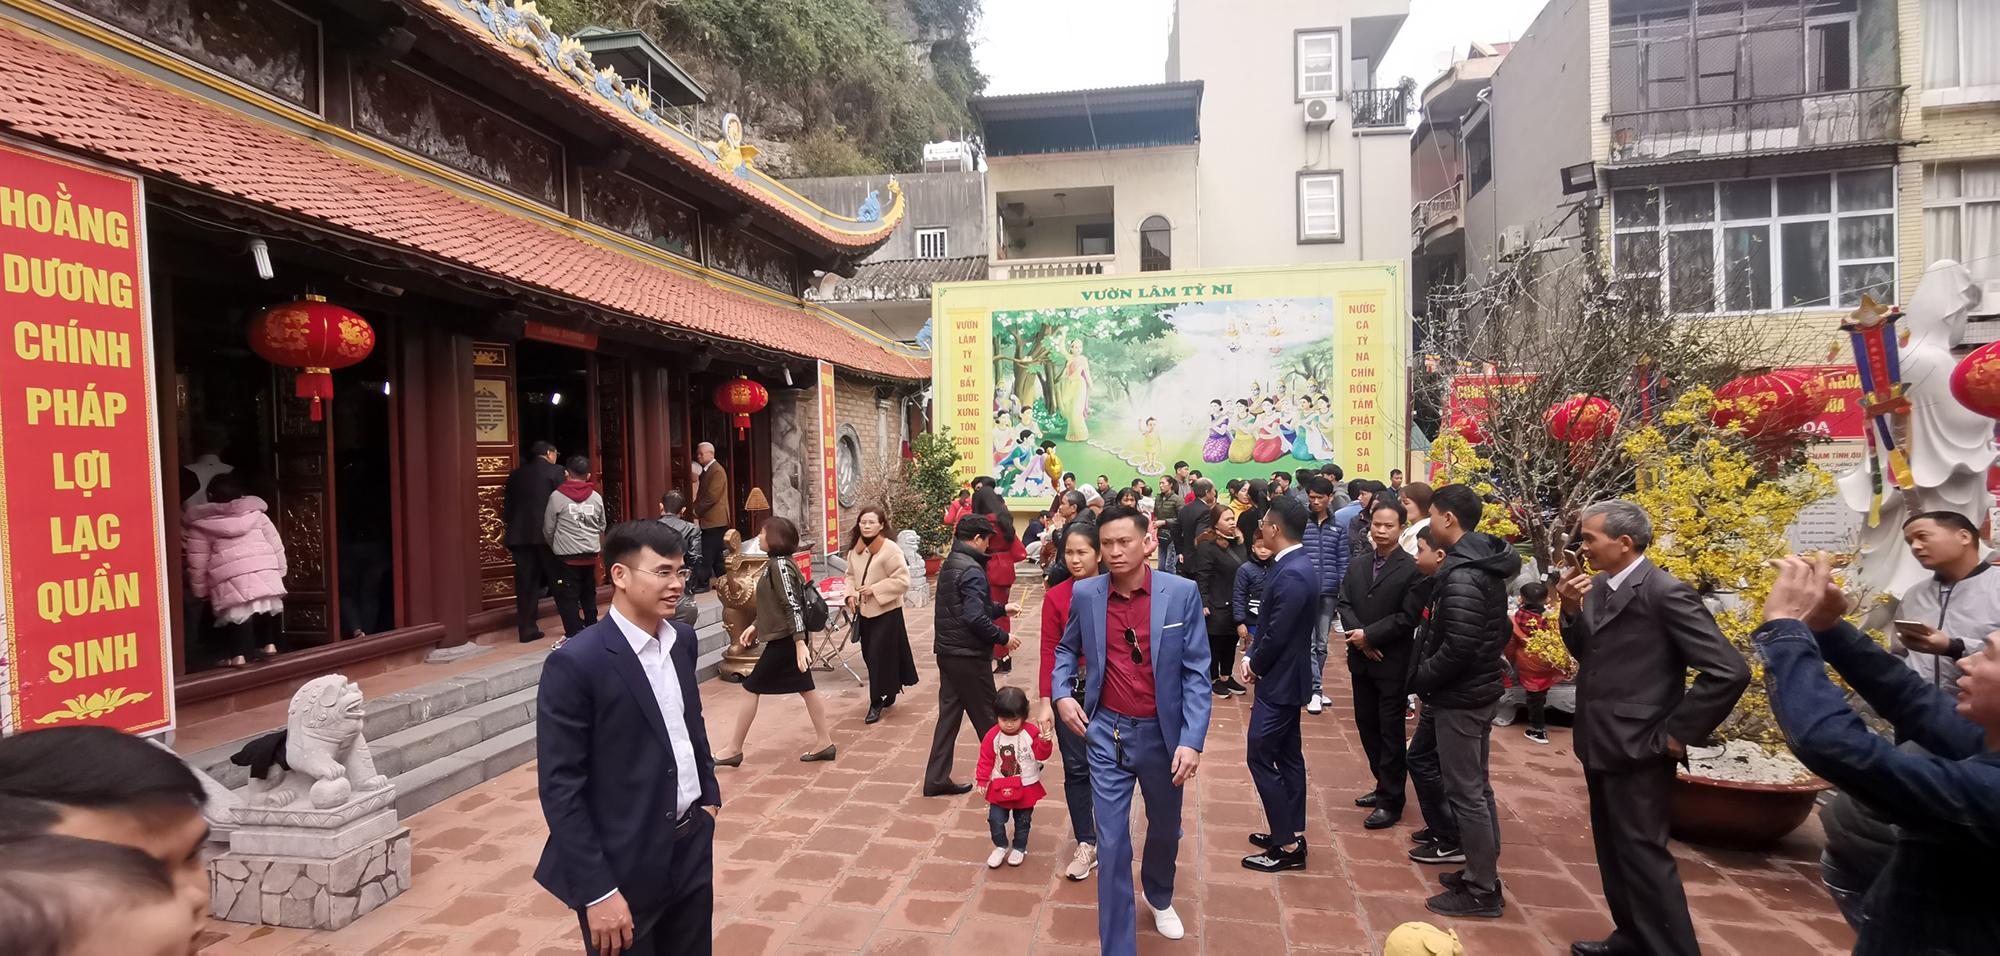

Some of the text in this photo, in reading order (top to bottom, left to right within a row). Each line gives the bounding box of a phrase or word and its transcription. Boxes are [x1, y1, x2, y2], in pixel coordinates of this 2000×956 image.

[0, 182, 129, 249] HOẰNG
[3, 253, 133, 309] DƯƠNG
[1081, 287, 1132, 301] VƯỜN
[1138, 285, 1176, 298] LÂM
[1211, 284, 1233, 295] NI
[1348, 301, 1376, 314] NƯỚC
[1356, 320, 1369, 330] CA
[14, 319, 131, 368] CHÍNH
[1356, 352, 1370, 361] NA
[963, 364, 972, 373] NI
[26, 383, 127, 427] PHÁP
[53, 450, 111, 497] LỢI
[1357, 447, 1370, 456] SA
[50, 513, 120, 560] LẠC
[37, 562, 140, 624] QUẦN
[48, 632, 138, 684] SINH
